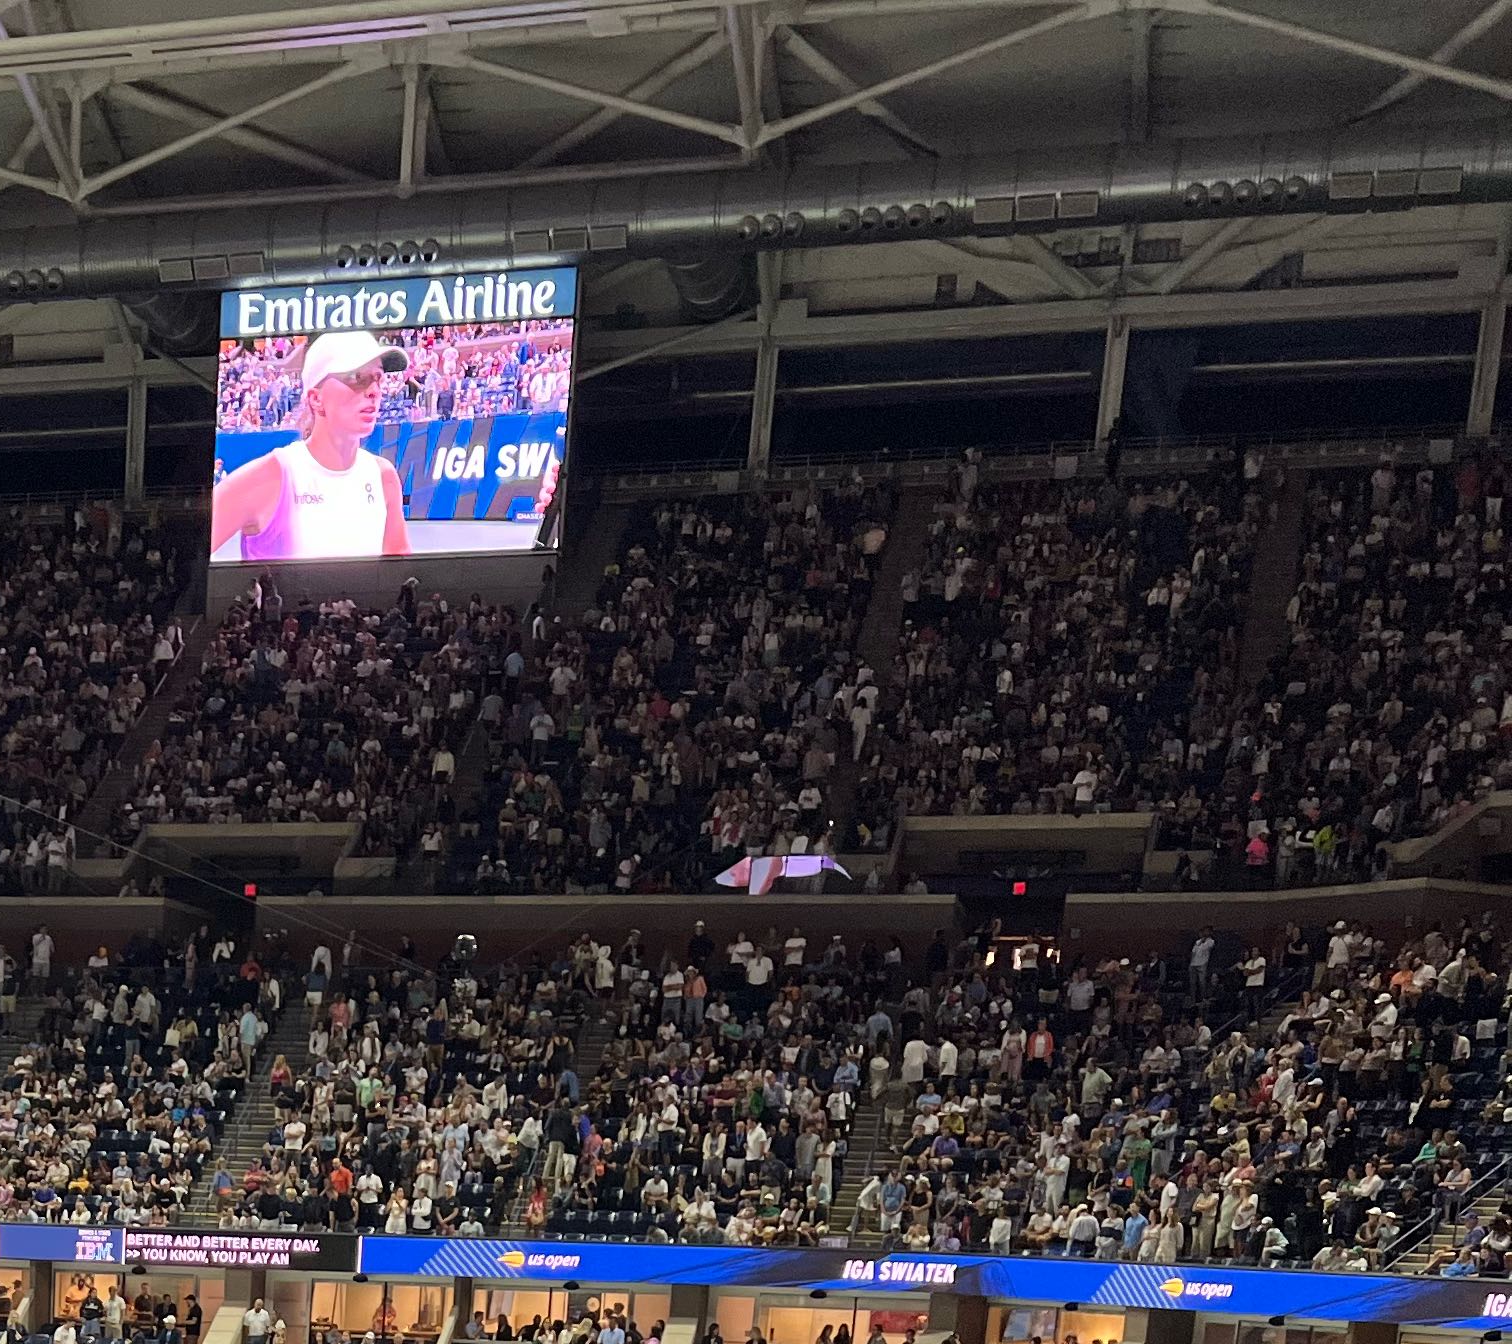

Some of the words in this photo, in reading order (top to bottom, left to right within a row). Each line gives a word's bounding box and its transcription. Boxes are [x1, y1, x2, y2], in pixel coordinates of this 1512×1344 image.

[239, 286, 407, 334] Emirates
[417, 273, 556, 323] Airline
[432, 445, 485, 480] IGA
[76, 1241, 115, 1261] IBM
[126, 1233, 174, 1246] BETTER
[174, 1235, 200, 1248] AND
[202, 1236, 249, 1249] BETTER
[251, 1238, 292, 1250] EVERY
[293, 1239, 320, 1253] DAY.
[143, 1248, 168, 1261] YOU
[170, 1249, 209, 1264] KNOW,
[212, 1250, 237, 1263] YOU
[239, 1252, 271, 1265] PLAY
[271, 1253, 289, 1265] AN
[528, 1254, 545, 1266] us
[544, 1254, 581, 1270] open
[842, 1260, 875, 1280] IGA
[878, 1261, 957, 1283] SWIATEK
[1185, 1282, 1201, 1295] us
[1201, 1283, 1233, 1300] open
